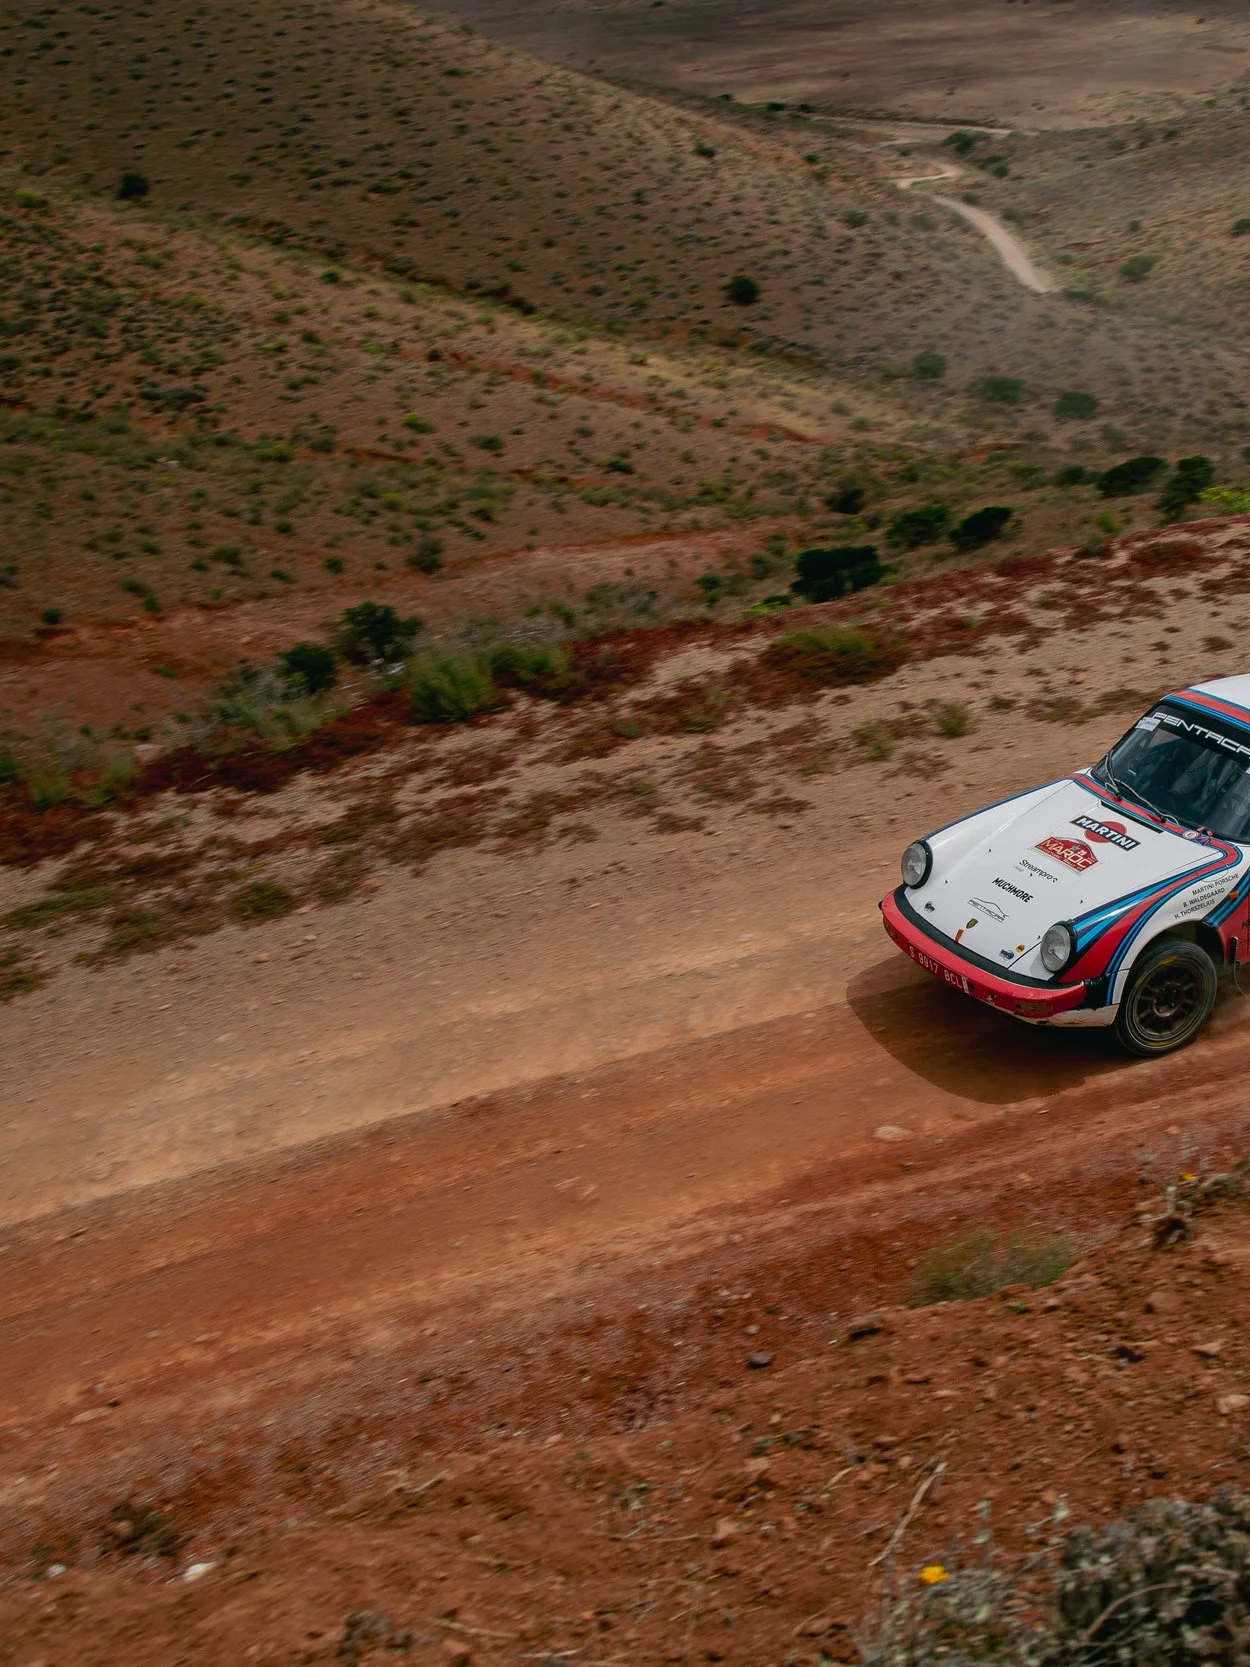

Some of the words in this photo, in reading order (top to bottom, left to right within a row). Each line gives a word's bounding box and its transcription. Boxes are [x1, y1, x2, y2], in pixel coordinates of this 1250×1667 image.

[1075, 816, 1137, 850] MARTINI
[1040, 839, 1093, 869] MAROC
[991, 877, 1034, 903] MUCHMORE
[1192, 883, 1215, 896] MARTINI
[1215, 873, 1239, 888] PORSCHE
[1180, 899, 1216, 917] THORSZELIUS
